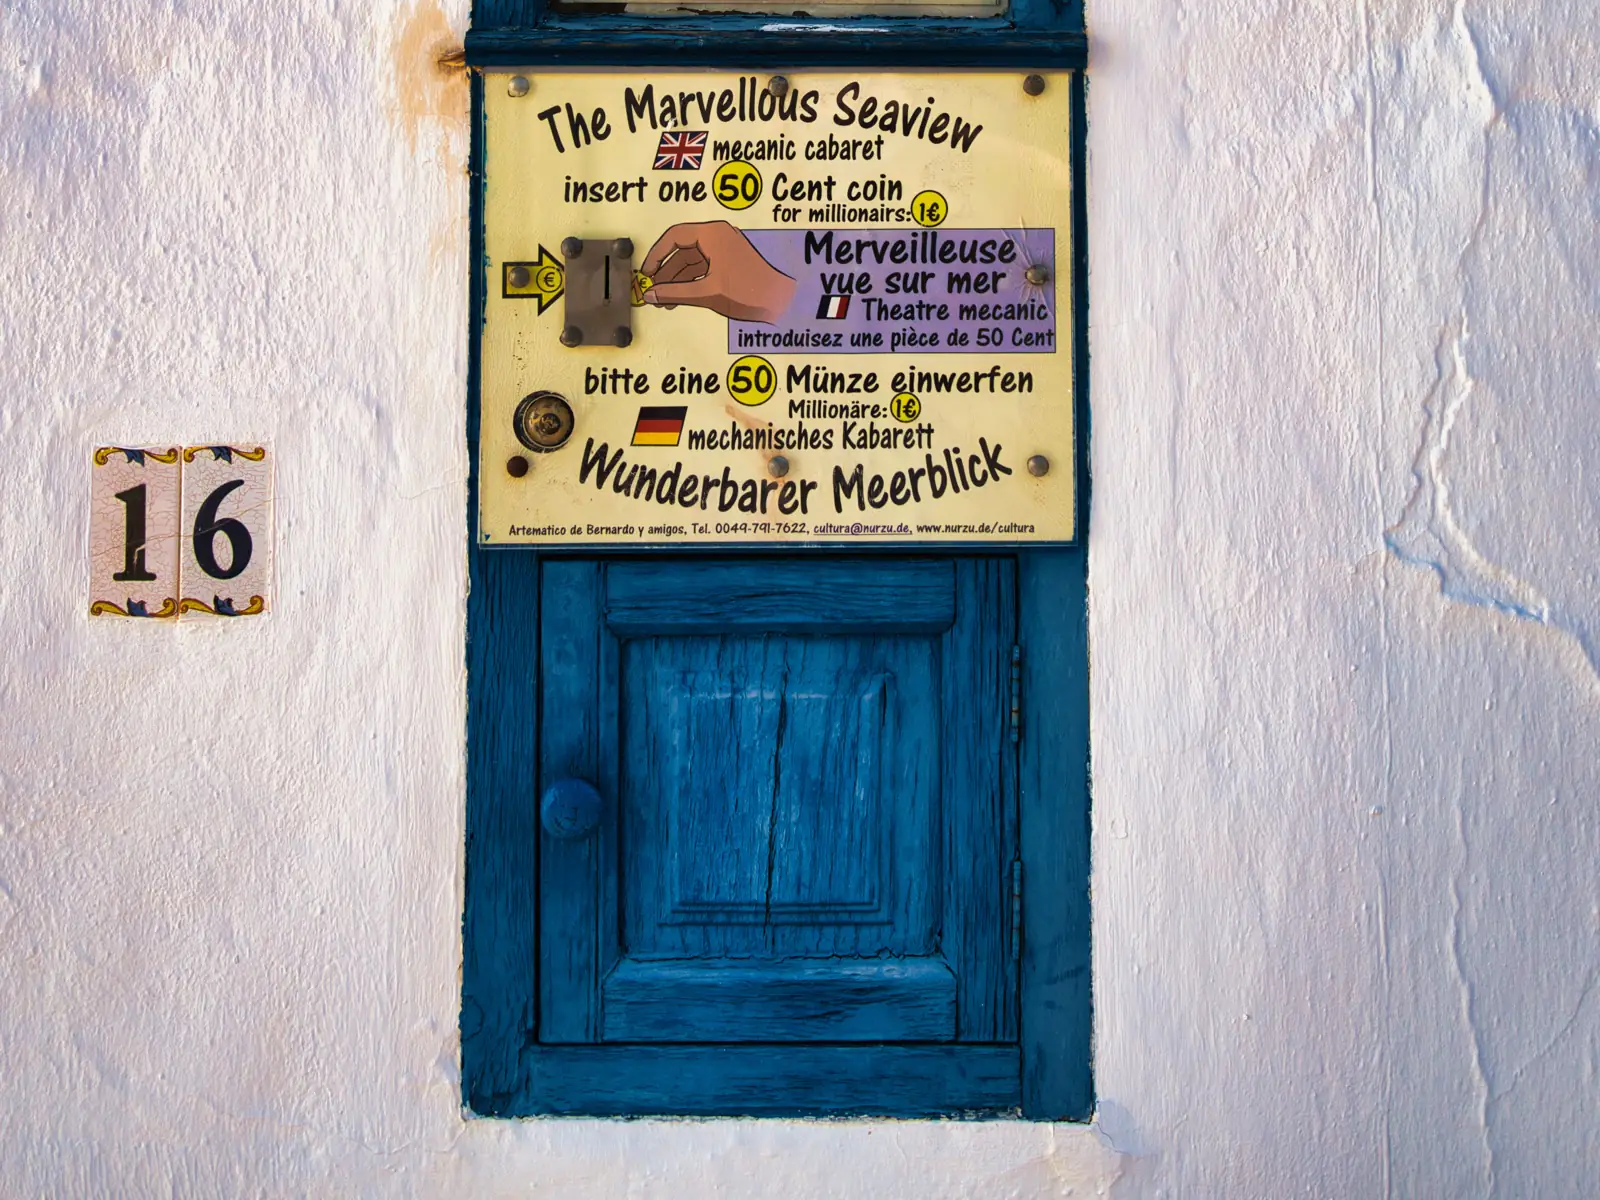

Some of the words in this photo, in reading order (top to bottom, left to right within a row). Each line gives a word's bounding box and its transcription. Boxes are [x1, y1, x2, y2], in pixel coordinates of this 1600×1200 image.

[538, 103, 611, 153] The
[625, 77, 819, 130] Marvellous
[832, 82, 983, 153] Seaview
[713, 134, 796, 161] mecanic
[805, 133, 884, 160] cabaret
[565, 176, 648, 202] insert
[659, 181, 707, 202] one
[718, 174, 758, 200] 50
[772, 173, 836, 201] Cent
[847, 175, 902, 201] coin
[773, 204, 800, 222] for
[809, 204, 911, 222] millionairs:
[919, 203, 941, 222] 1€
[804, 231, 1016, 264] Merveilleuse
[820, 273, 872, 294] vue
[886, 271, 935, 294] sur
[948, 271, 1006, 294] mer
[862, 298, 949, 320] Theatre
[959, 299, 1048, 320] mecanic
[739, 329, 842, 347] introduisez
[851, 333, 883, 347] une
[891, 327, 939, 352] pièce
[947, 329, 969, 346] de
[977, 328, 1003, 346] 50
[1012, 328, 1054, 347] Cent
[585, 367, 649, 394] bitte
[662, 368, 719, 394] eine
[732, 366, 771, 394] 50
[787, 365, 879, 393] Münze
[891, 366, 1032, 394] einwerfen
[789, 400, 887, 418] Millionäre:
[895, 399, 917, 421] 1€
[689, 425, 833, 450] mechanisches
[843, 421, 934, 449] Kabarett
[579, 438, 818, 514] Wunderbarer
[833, 438, 1012, 513] Meerblick
[113, 480, 252, 581] 16
[509, 525, 566, 535] Artematico
[570, 525, 582, 535] de
[587, 524, 634, 534] Bernardo
[639, 527, 644, 537] y
[648, 524, 687, 536] amigos,
[692, 523, 710, 533] Tel.
[716, 523, 809, 534] 0049-791-7622,
[814, 523, 912, 535] cultura@nurzu.de,
[917, 522, 1034, 533] www.nurzu.de/cultura
